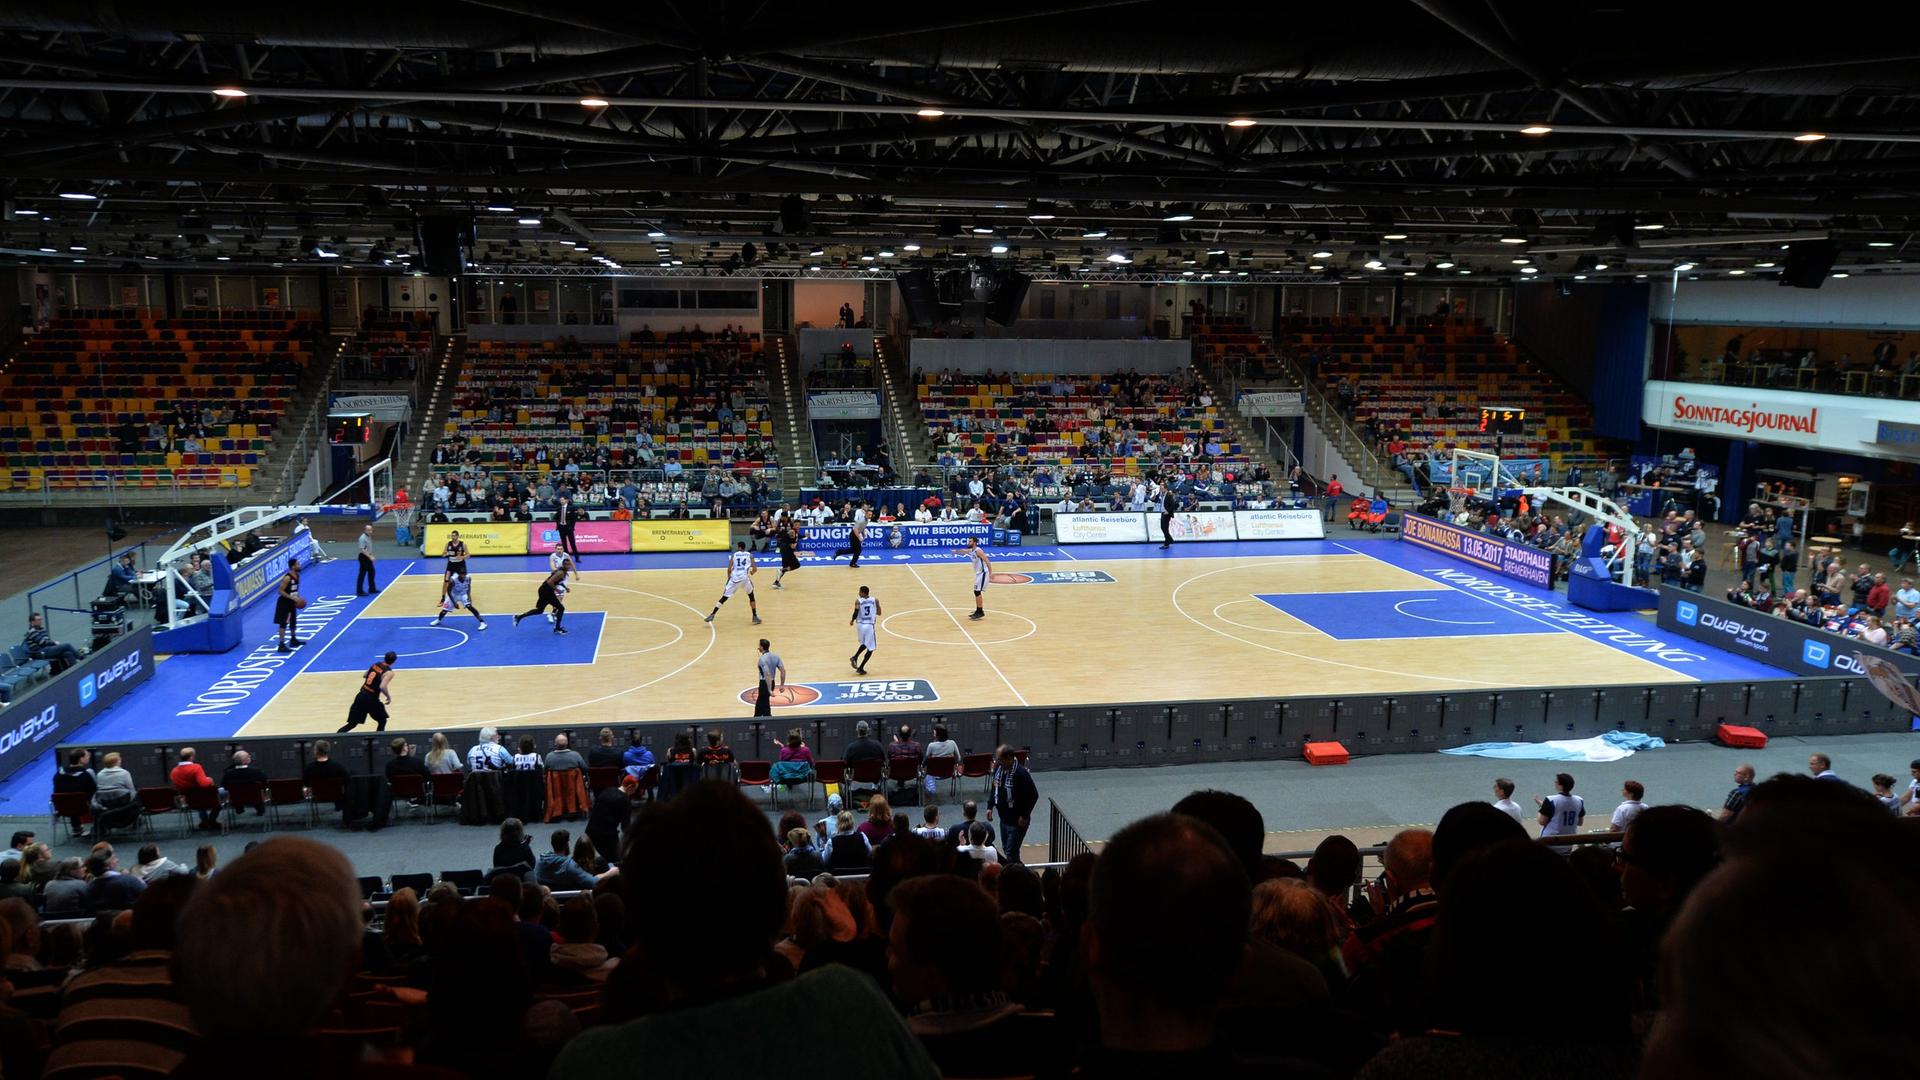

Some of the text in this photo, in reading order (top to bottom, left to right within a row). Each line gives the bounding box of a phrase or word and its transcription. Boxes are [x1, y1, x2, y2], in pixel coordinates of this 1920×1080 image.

[802, 528, 883, 540] JUNGHNS
[909, 526, 988, 535] WIR BEKOMMEN
[909, 538, 938, 546] ALLES
[1404, 519, 1503, 564] JOE BONAMASSA 13.05.2017
[1505, 546, 1550, 570] STADTHALLE
[1504, 560, 1549, 585] BREMERHAVEN
[864, 605, 871, 616] 3
[1563, 810, 1576, 827] 18
